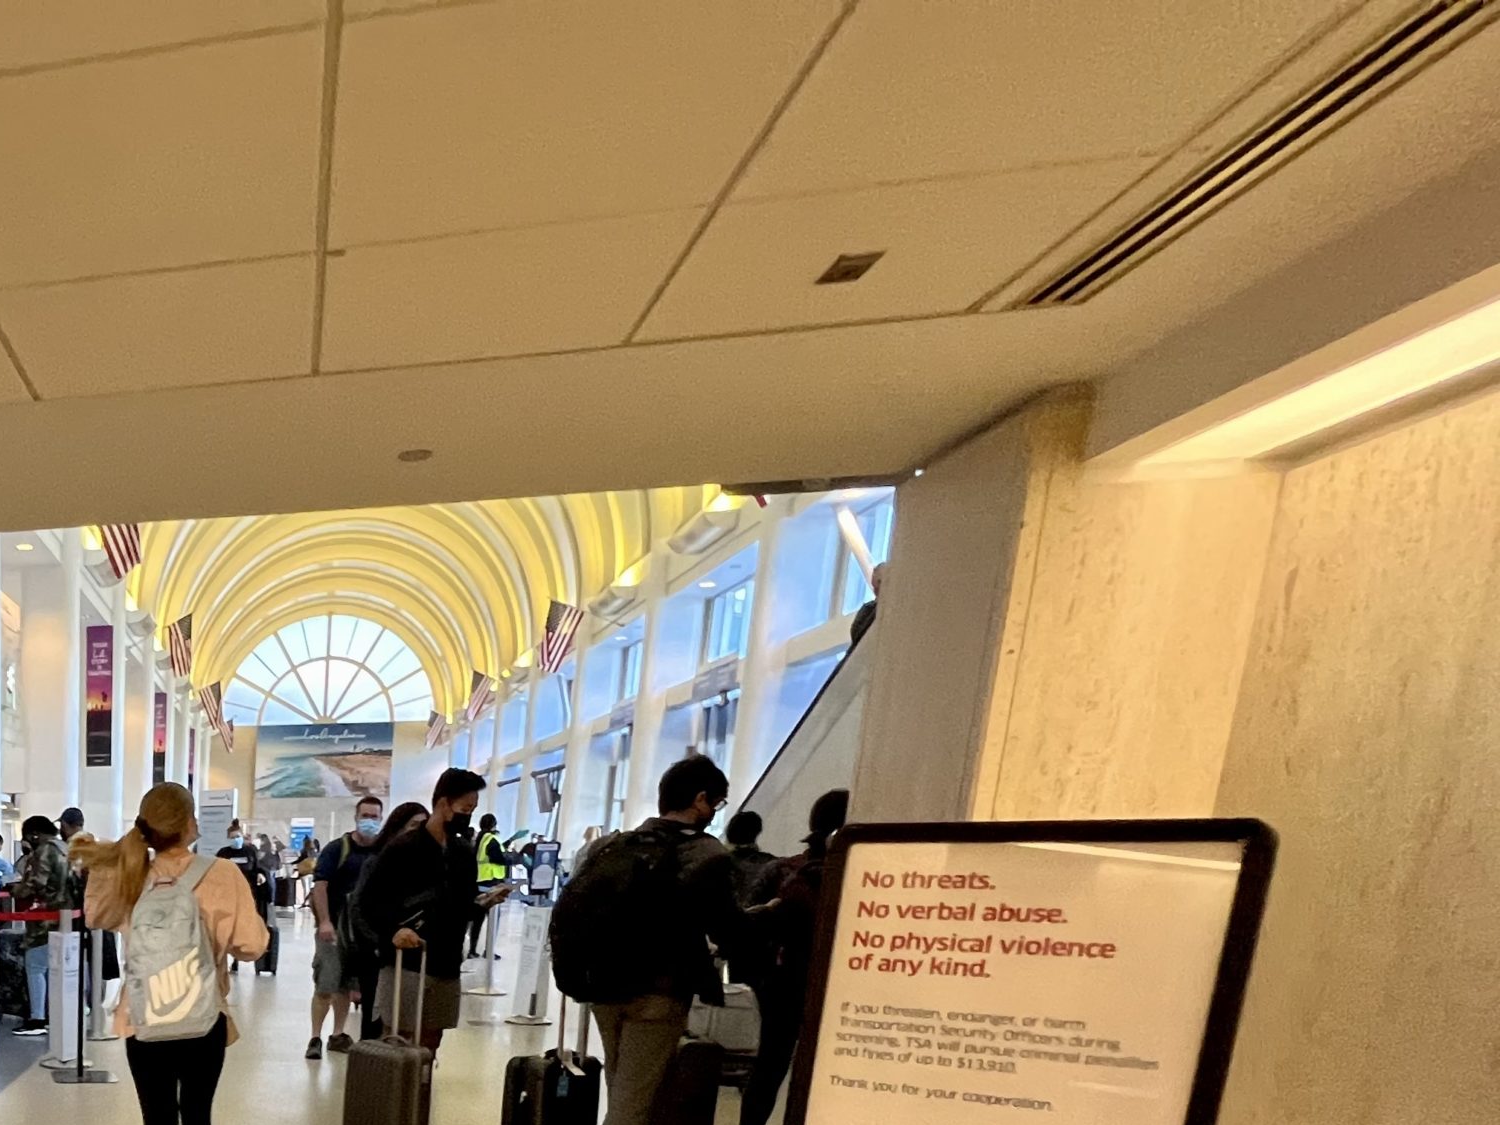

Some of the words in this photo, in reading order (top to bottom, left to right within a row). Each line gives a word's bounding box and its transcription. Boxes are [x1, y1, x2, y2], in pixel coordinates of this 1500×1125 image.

[861, 870, 895, 889] No
[901, 871, 997, 890] threats.
[857, 900, 890, 918] No
[896, 901, 976, 921] verbal
[982, 904, 1068, 923] abuse.
[852, 930, 885, 948] No
[889, 932, 993, 955] physical
[999, 935, 1117, 959] violence
[848, 953, 873, 970] of
[877, 957, 923, 976] any
[928, 956, 991, 978] kind.
[840, 1001, 850, 1012] If
[854, 1004, 879, 1015] you
[1021, 1017, 1040, 1028] or
[1043, 1016, 1086, 1030] harm
[840, 1015, 936, 1034] Transportation
[939, 1024, 997, 1041] Security
[1003, 1029, 1065, 1045] Officers
[1068, 1036, 1121, 1052] during
[833, 1046, 859, 1057] and
[861, 1047, 894, 1061] fines
[897, 1051, 914, 1063] of
[916, 1055, 934, 1066] up
[937, 1055, 953, 1067] to
[906, 1036, 933, 1049] TSA
[937, 1040, 961, 1052] will
[964, 1042, 1016, 1057] pursue
[829, 1074, 868, 1089] Thank
[872, 1080, 899, 1093] you
[901, 1082, 921, 1095] for
[925, 1087, 959, 1100] your
